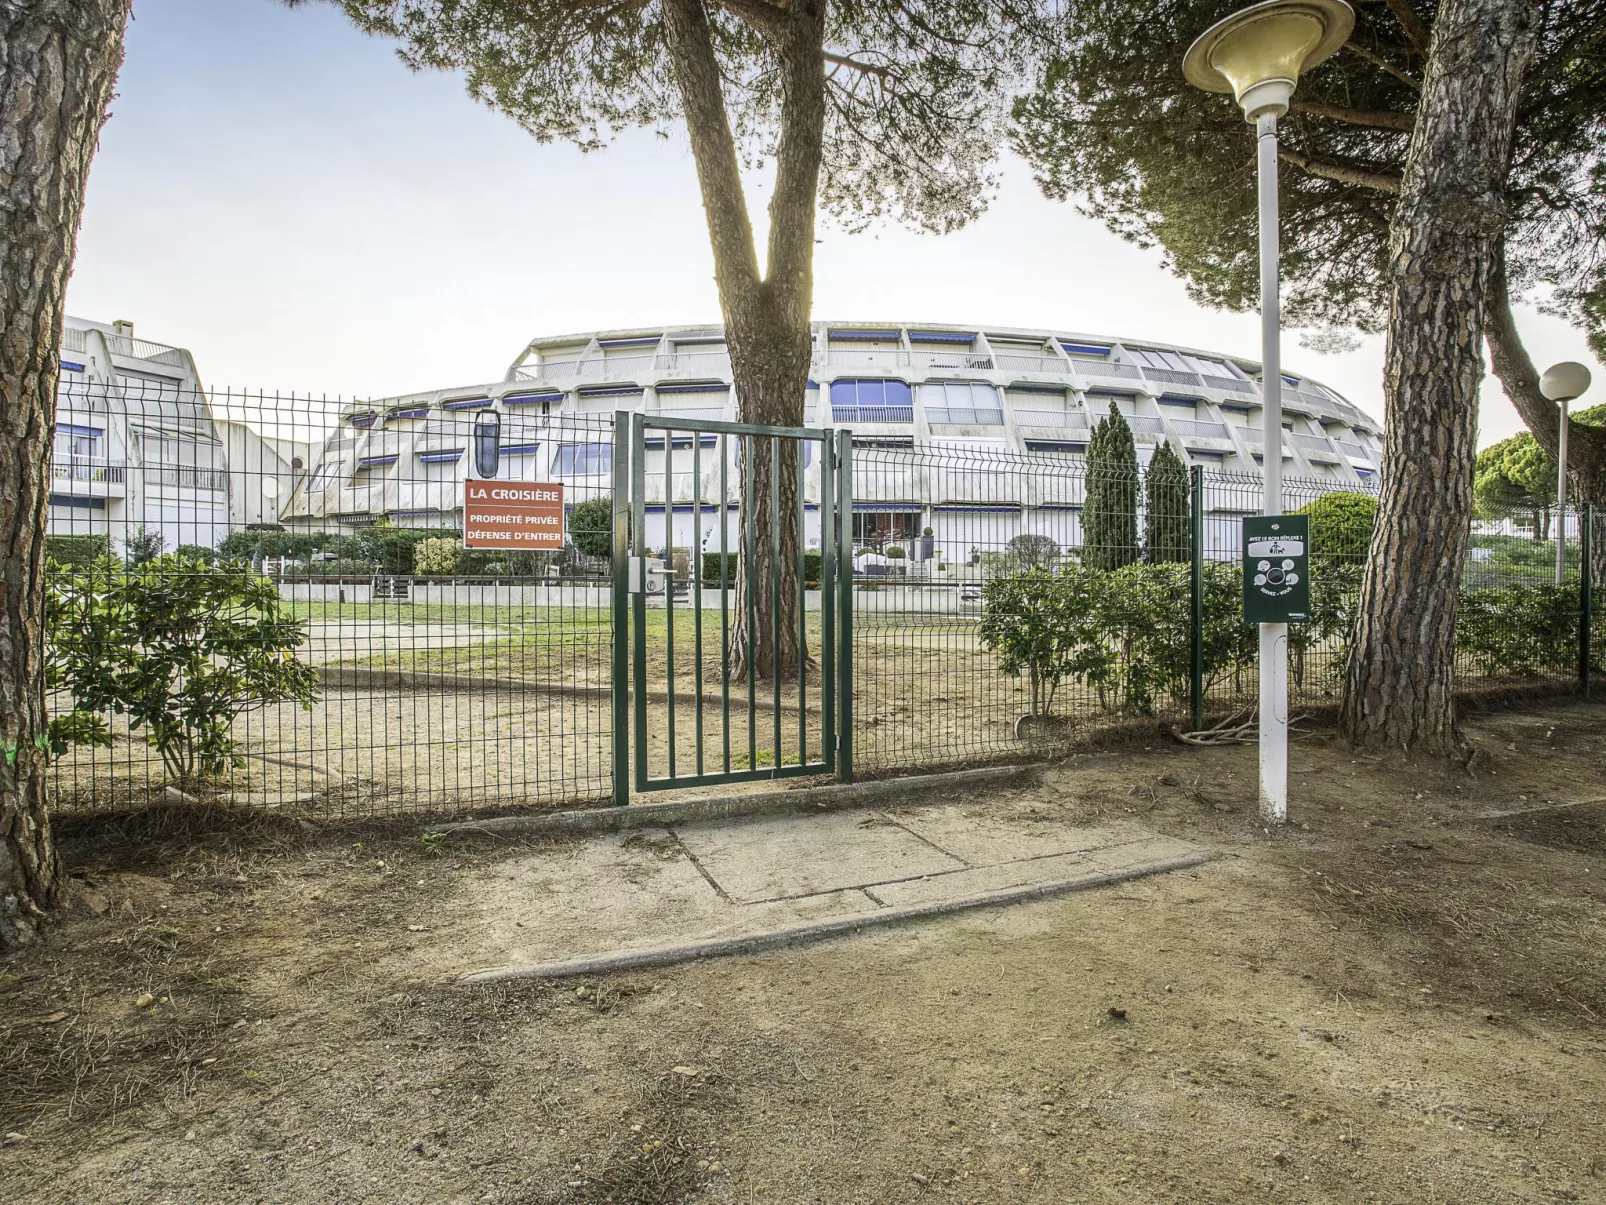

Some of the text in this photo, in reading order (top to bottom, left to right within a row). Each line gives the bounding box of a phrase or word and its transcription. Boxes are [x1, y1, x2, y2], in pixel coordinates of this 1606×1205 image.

[470, 488, 558, 501] LA CROISIÈRE
[470, 514, 558, 524] PROPRIÉTÉ PRIVÉE
[468, 530, 560, 540] DÉFENSE D'ENTRER
